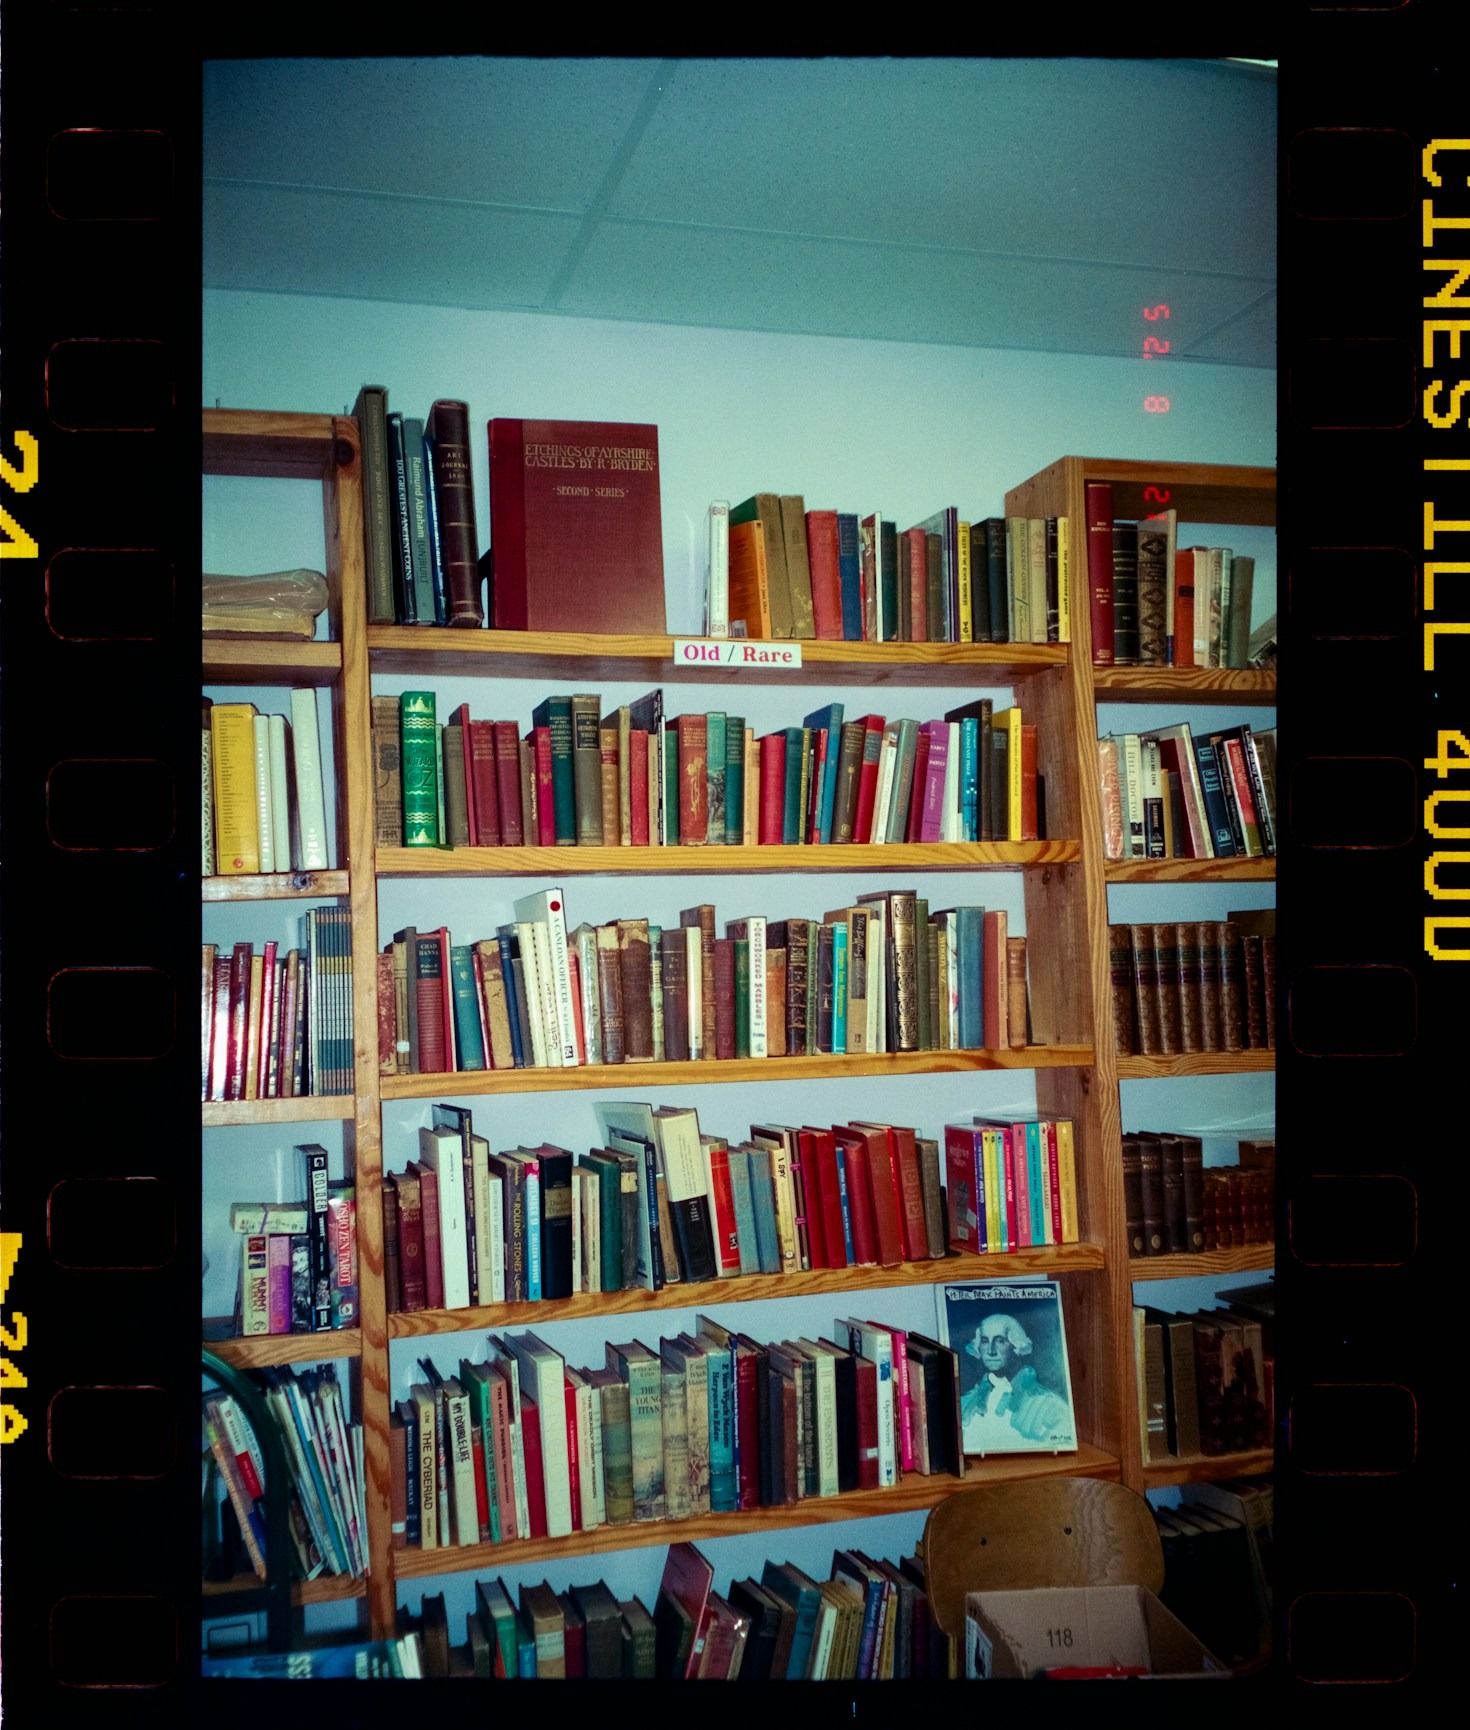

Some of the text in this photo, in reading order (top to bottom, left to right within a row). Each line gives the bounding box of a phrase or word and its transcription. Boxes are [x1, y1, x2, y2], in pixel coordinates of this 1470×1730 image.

[525, 444, 582, 458] ETCHINGS
[598, 446, 652, 459] AYRSHIRE
[525, 456, 575, 468] CASTLES
[580, 457, 593, 468] BY
[610, 458, 653, 471] BRYDEN
[412, 457, 423, 496] Raimund
[556, 486, 625, 498] SECOND SERIES
[396, 459, 413, 581] 100 GREATEST ANCIENT COINS
[414, 498, 426, 538] Abraham
[1423, 139, 1470, 960] CINESTILL 400D
[682, 644, 722, 661] Old
[742, 647, 793, 663] Rare
[1245, 730, 1254, 753] Lucky
[1108, 757, 1118, 790] RIVER
[1127, 751, 1139, 820] HILL DOCTOR
[856, 916, 865, 930] This
[553, 923, 565, 966] CANLOAN
[852, 930, 865, 958] Baffling
[558, 967, 568, 1004] OFFICER
[778, 1164, 786, 1179] SPY
[313, 1171, 327, 1212] COLDER
[528, 1174, 539, 1216] NOVEMBER
[513, 1202, 522, 1238] ROLLING
[339, 1202, 351, 1283] OSHO ZEN TAROT
[513, 1241, 522, 1272] STONES
[530, 1233, 539, 1259] COLLEEN
[531, 1260, 539, 1284] HOOVER
[257, 1276, 266, 1312] MUMMY
[973, 1289, 993, 1299] MAX
[1021, 1288, 1055, 1299] AMERICA
[641, 1386, 656, 1395] THE
[710, 1371, 719, 1409] Harpoon
[901, 1358, 909, 1396] AMATORIA
[423, 1410, 431, 1424] LEM
[635, 1397, 661, 1406] YOUNG
[721, 1391, 730, 1416] Wyck
[452, 1402, 470, 1463] MY DOUBLE LIFE
[485, 1418, 494, 1428] ABE
[803, 1379, 814, 1468] the bottom of the harbor
[822, 1384, 834, 1468] THE EMIGRANTS
[883, 1399, 892, 1447] Open Secrets
[422, 1430, 432, 1452] THE
[486, 1430, 495, 1455] LINCOLN
[499, 1428, 507, 1460] PUDDING
[407, 1479, 415, 1506] MACKAY
[422, 1456, 433, 1511] CYBERIAD
[489, 1483, 498, 1507] CHANCE
[1046, 1627, 1074, 1649] 118
